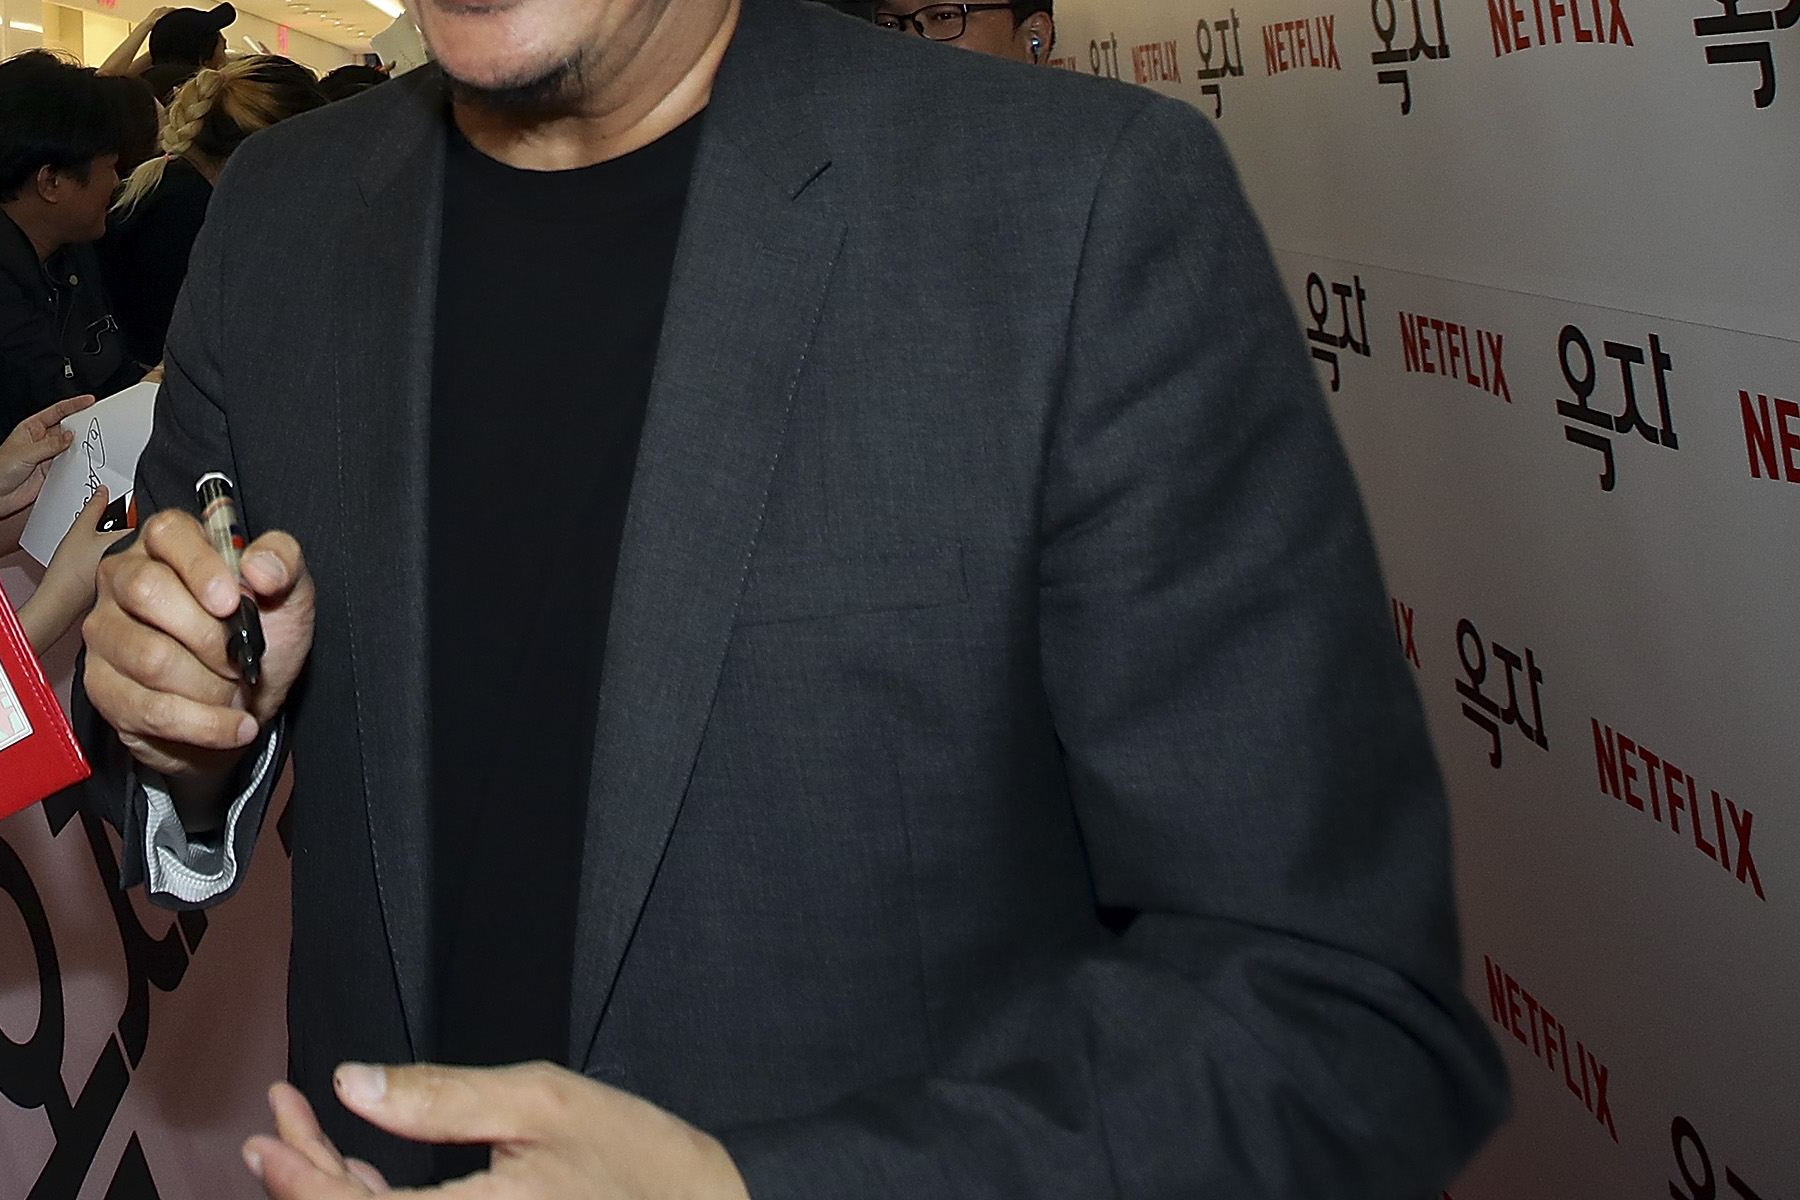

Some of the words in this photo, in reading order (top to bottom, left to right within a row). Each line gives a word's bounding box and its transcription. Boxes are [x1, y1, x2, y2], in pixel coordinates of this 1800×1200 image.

[1131, 40, 1182, 85] NETFLIX
[1197, 8, 1244, 119] 옥자
[1262, 15, 1341, 76] NETFLIX
[1307, 272, 1371, 392] 옥자
[1399, 312, 1511, 403] NETFLIX
[1556, 325, 1679, 491] 옥자
[1455, 618, 1549, 769] 옥자
[1591, 718, 1766, 901] NETFLIX
[1484, 955, 1618, 1143] NETFLIX
